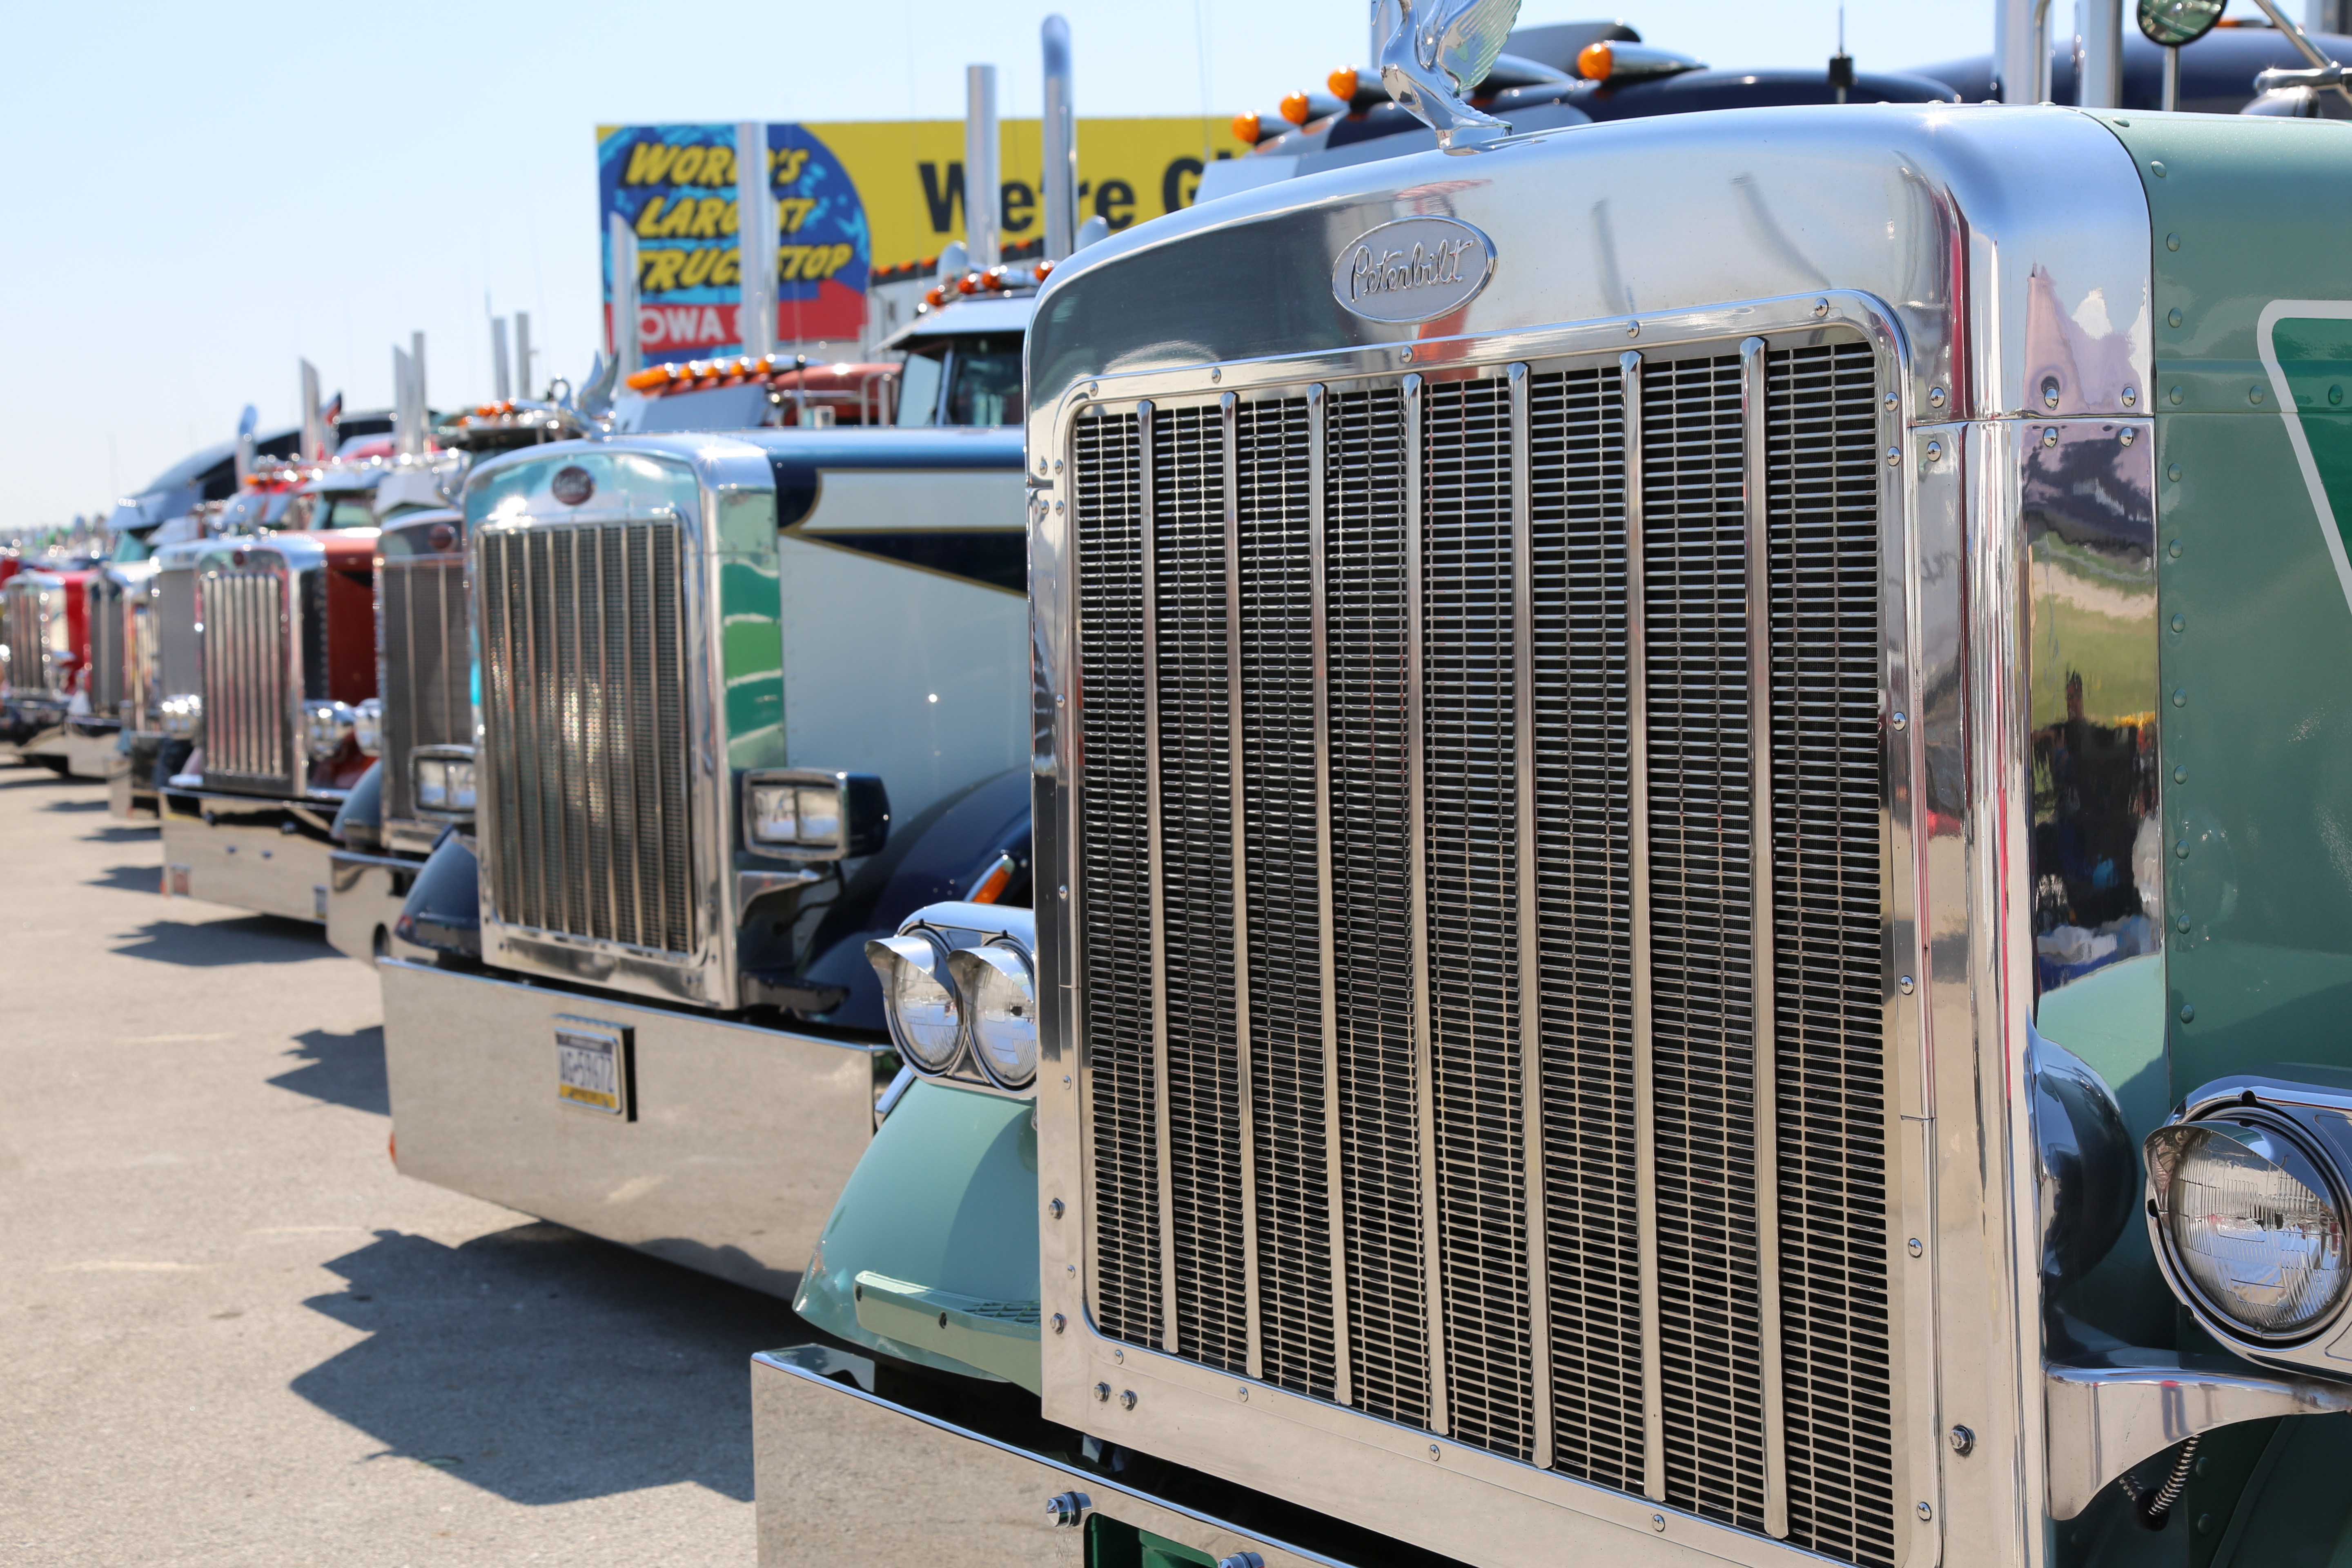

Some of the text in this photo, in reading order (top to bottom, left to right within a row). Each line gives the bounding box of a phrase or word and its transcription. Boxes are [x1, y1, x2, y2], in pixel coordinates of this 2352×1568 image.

[625, 141, 810, 186] WOR'S
[1351, 238, 1476, 303] Peterbilt
[638, 305, 726, 345] OWA
[2220, 1225, 2258, 1240] HALOGEN
